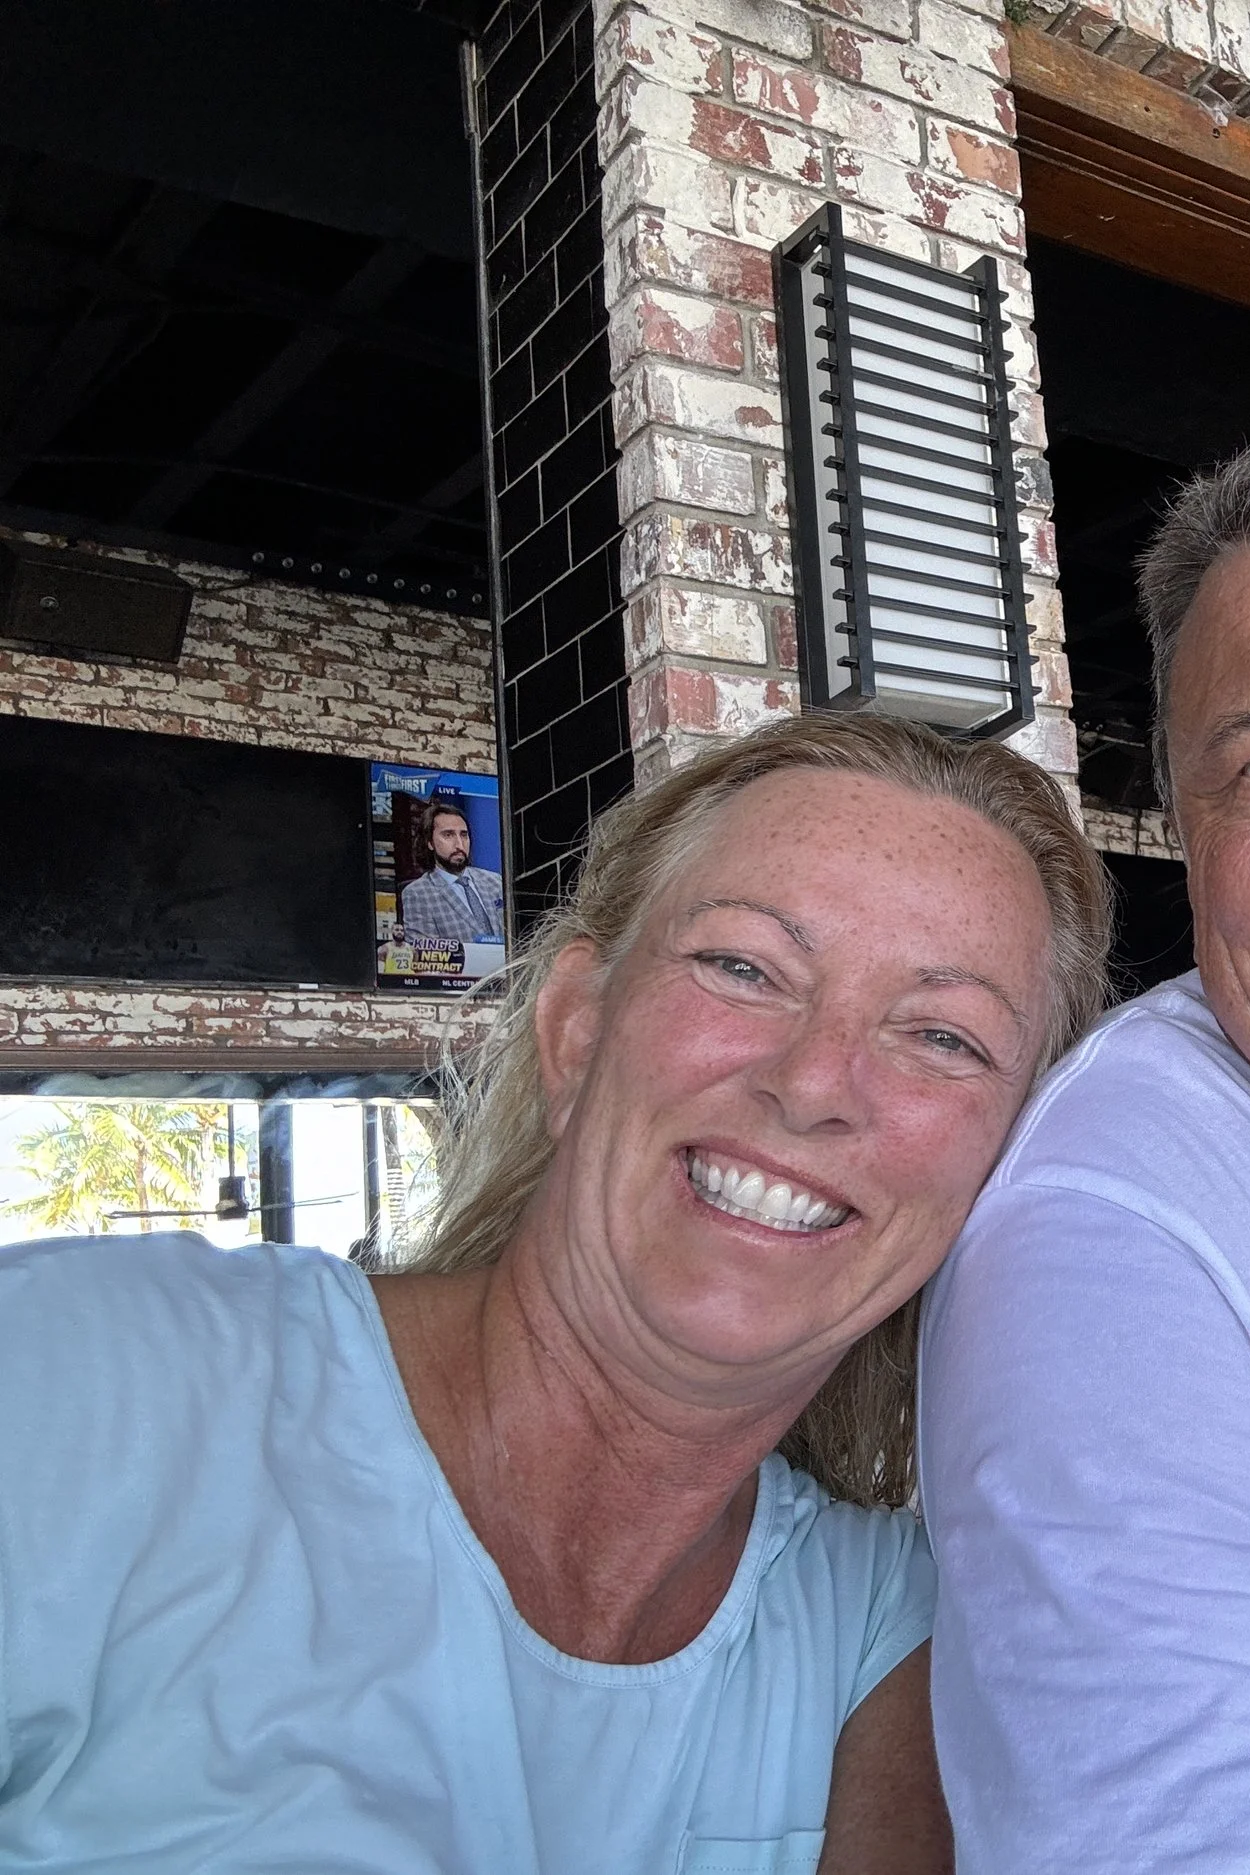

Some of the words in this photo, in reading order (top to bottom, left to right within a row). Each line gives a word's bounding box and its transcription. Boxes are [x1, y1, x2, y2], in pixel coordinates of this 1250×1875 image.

[401, 779, 427, 795] FIRST
[438, 786, 456, 795] LIVE
[412, 938, 460, 952] KING'S
[420, 951, 452, 962] NEW
[395, 958, 409, 970] 23
[411, 962, 463, 973] CONTRACT
[404, 978, 420, 986] MLB
